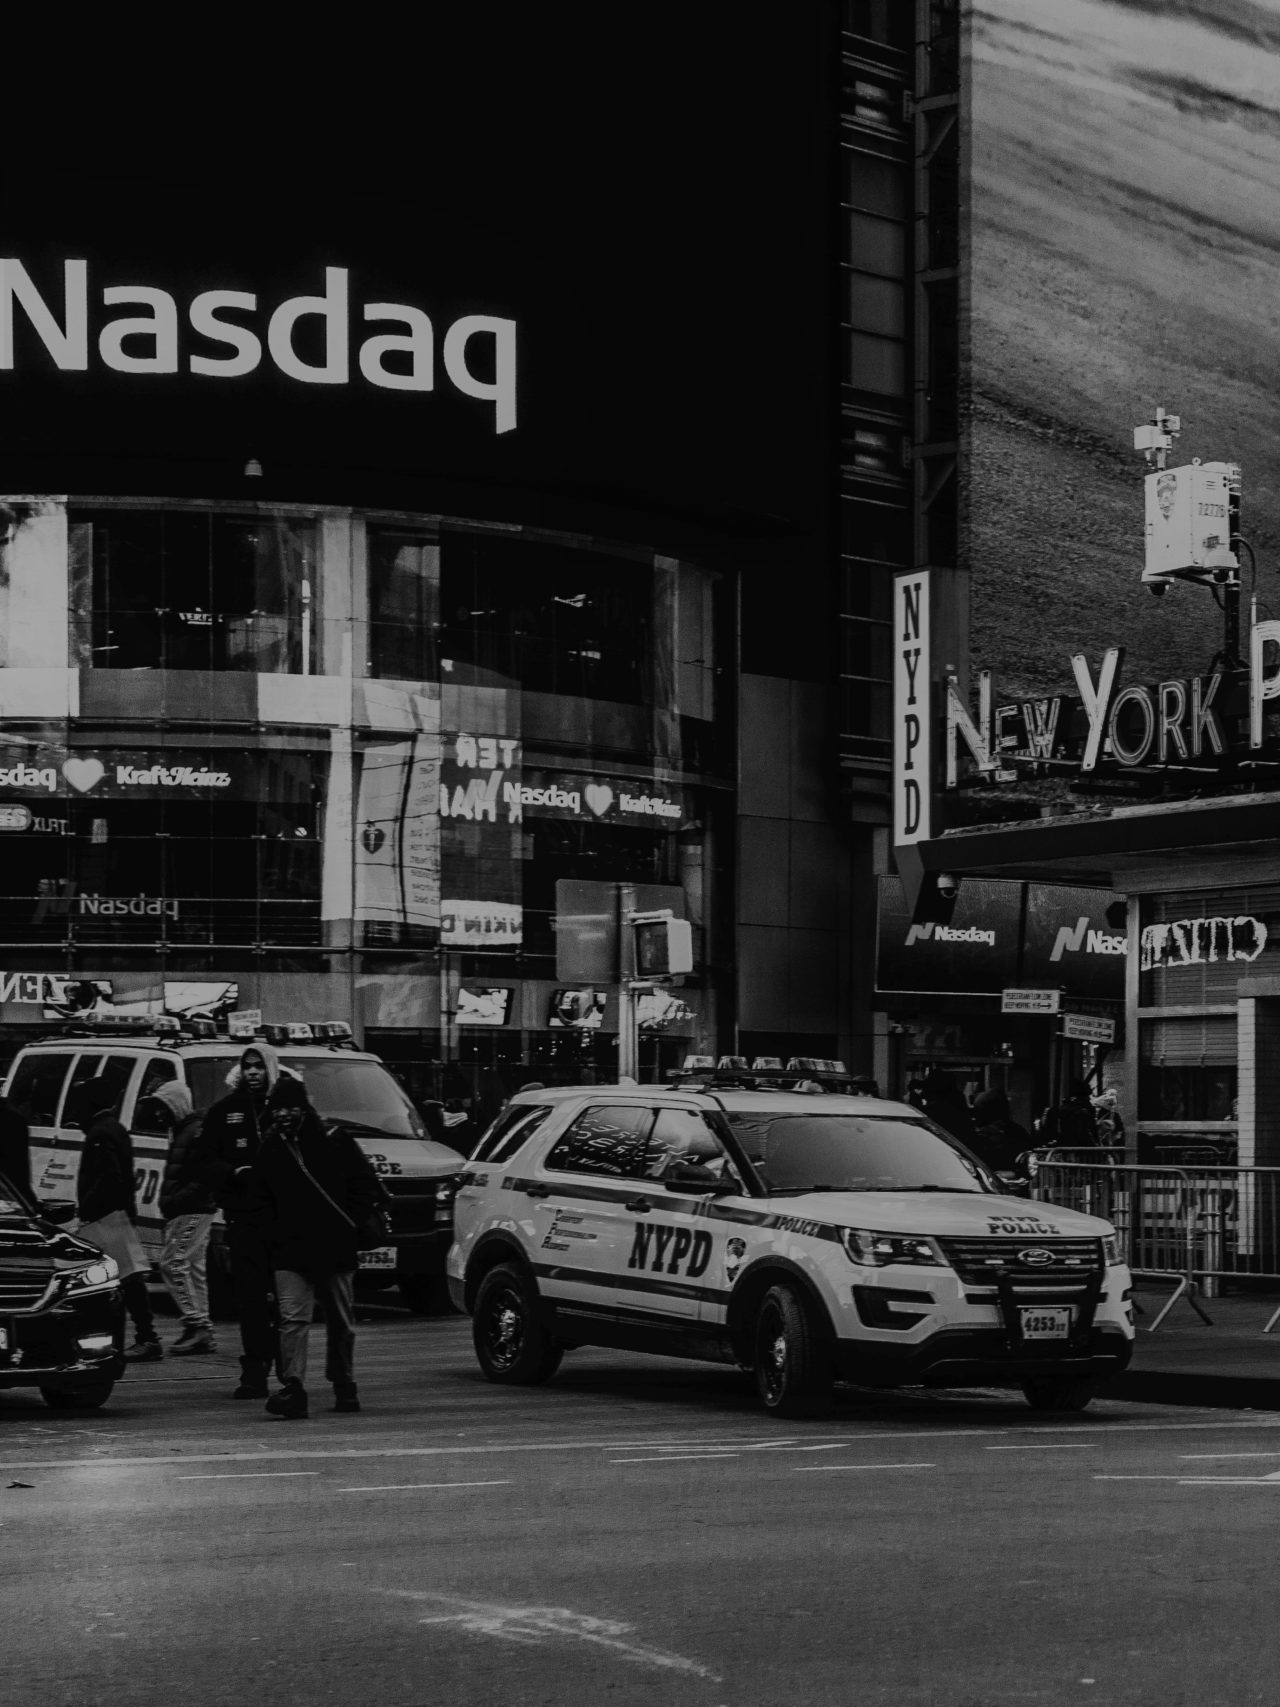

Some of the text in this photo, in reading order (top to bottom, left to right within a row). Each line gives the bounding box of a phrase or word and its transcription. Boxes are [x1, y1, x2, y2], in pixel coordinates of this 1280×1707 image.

[0, 258, 517, 434] Nasdaq
[903, 583, 922, 835] NYPD
[1070, 647, 1225, 772] YORK
[0, 764, 56, 791] sdaq
[503, 781, 580, 814] Nasdaq
[79, 892, 180, 921] Nasdaq
[934, 925, 995, 946] Nasdaq
[1086, 929, 1128, 955] Nas
[776, 1215, 820, 1237] POLICE
[986, 1223, 1061, 1235] POLICE
[628, 1222, 713, 1278] NYPD
[1024, 1316, 1056, 1332] 4253
